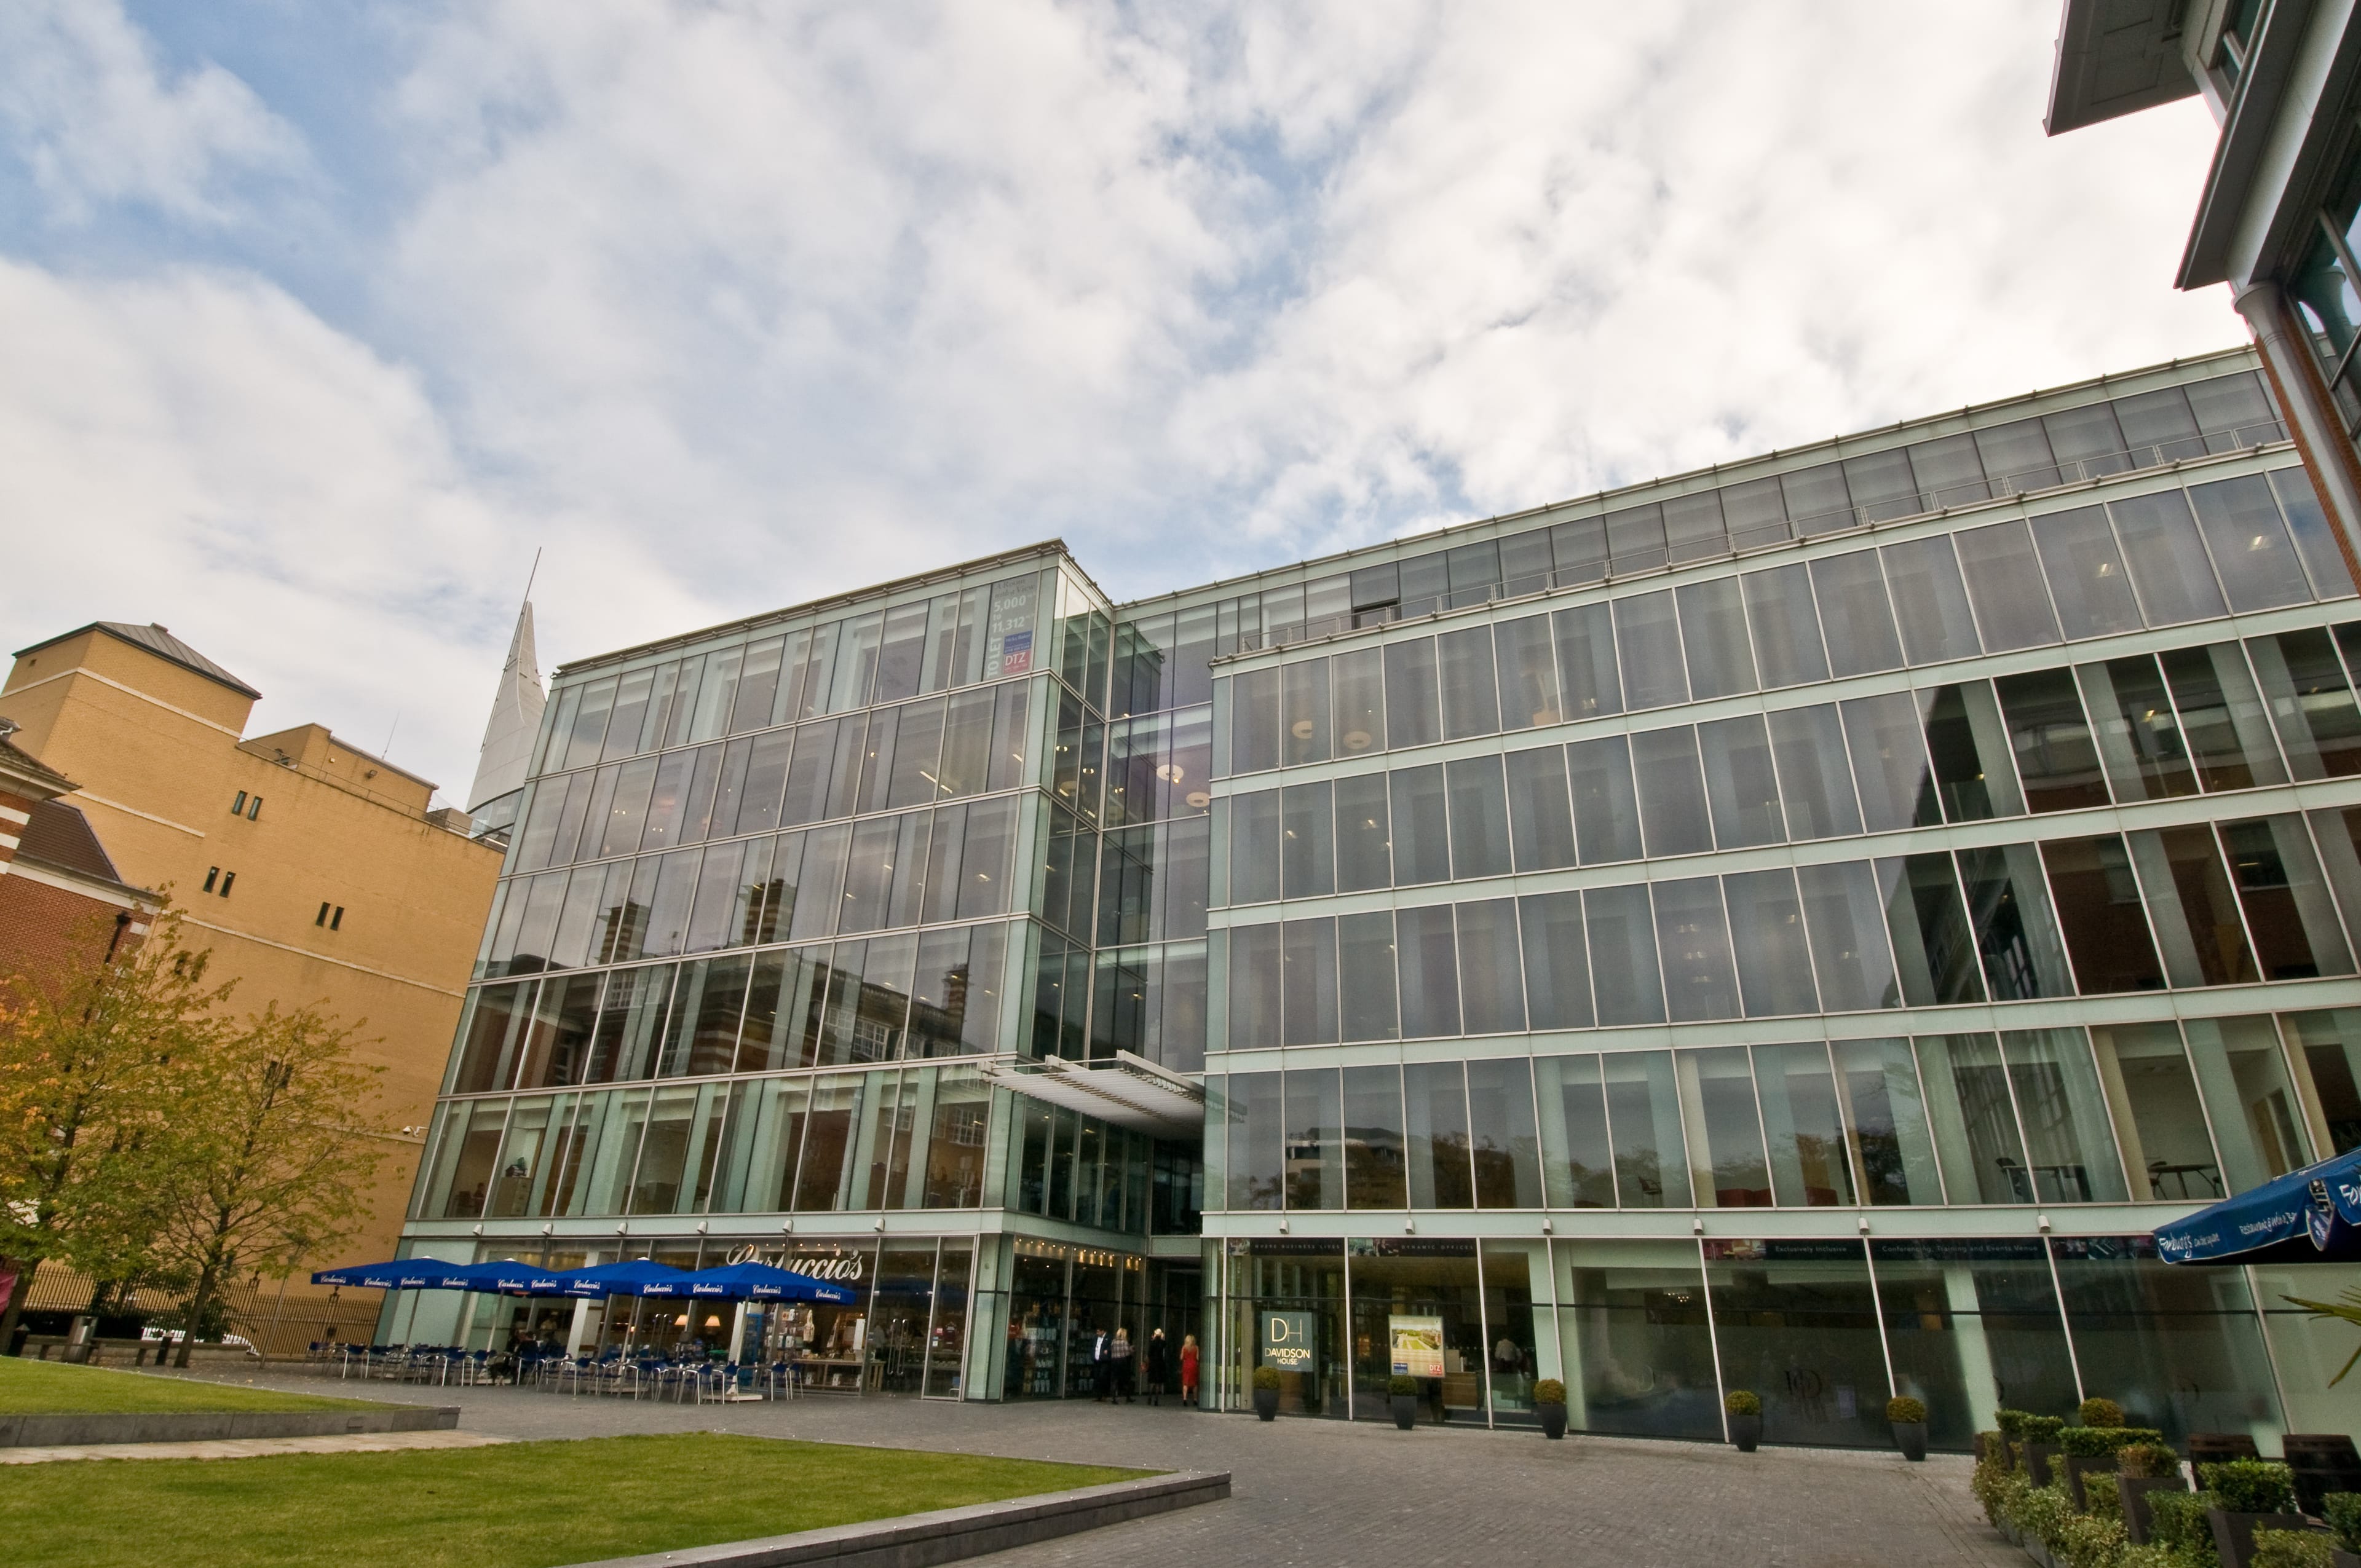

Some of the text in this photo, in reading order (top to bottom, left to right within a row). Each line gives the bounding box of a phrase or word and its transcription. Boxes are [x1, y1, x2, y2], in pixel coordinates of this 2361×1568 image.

[994, 595, 1026, 612] 5,000
[992, 617, 1025, 633] 11,312
[988, 637, 1002, 659] LET
[1005, 652, 1026, 666] DTZ
[726, 1245, 863, 1280] Crluccio's
[531, 1278, 556, 1288] Carluccio's
[574, 1279, 600, 1290] Carluccio's
[643, 1283, 673, 1294] Carluccio's
[693, 1283, 723, 1294] Carluccio's
[753, 1284, 781, 1294] Carluccio's
[815, 1288, 841, 1300] Carluccio's
[1271, 1318, 1302, 1342] DH
[1265, 1347, 1310, 1358] DAVIDSON
